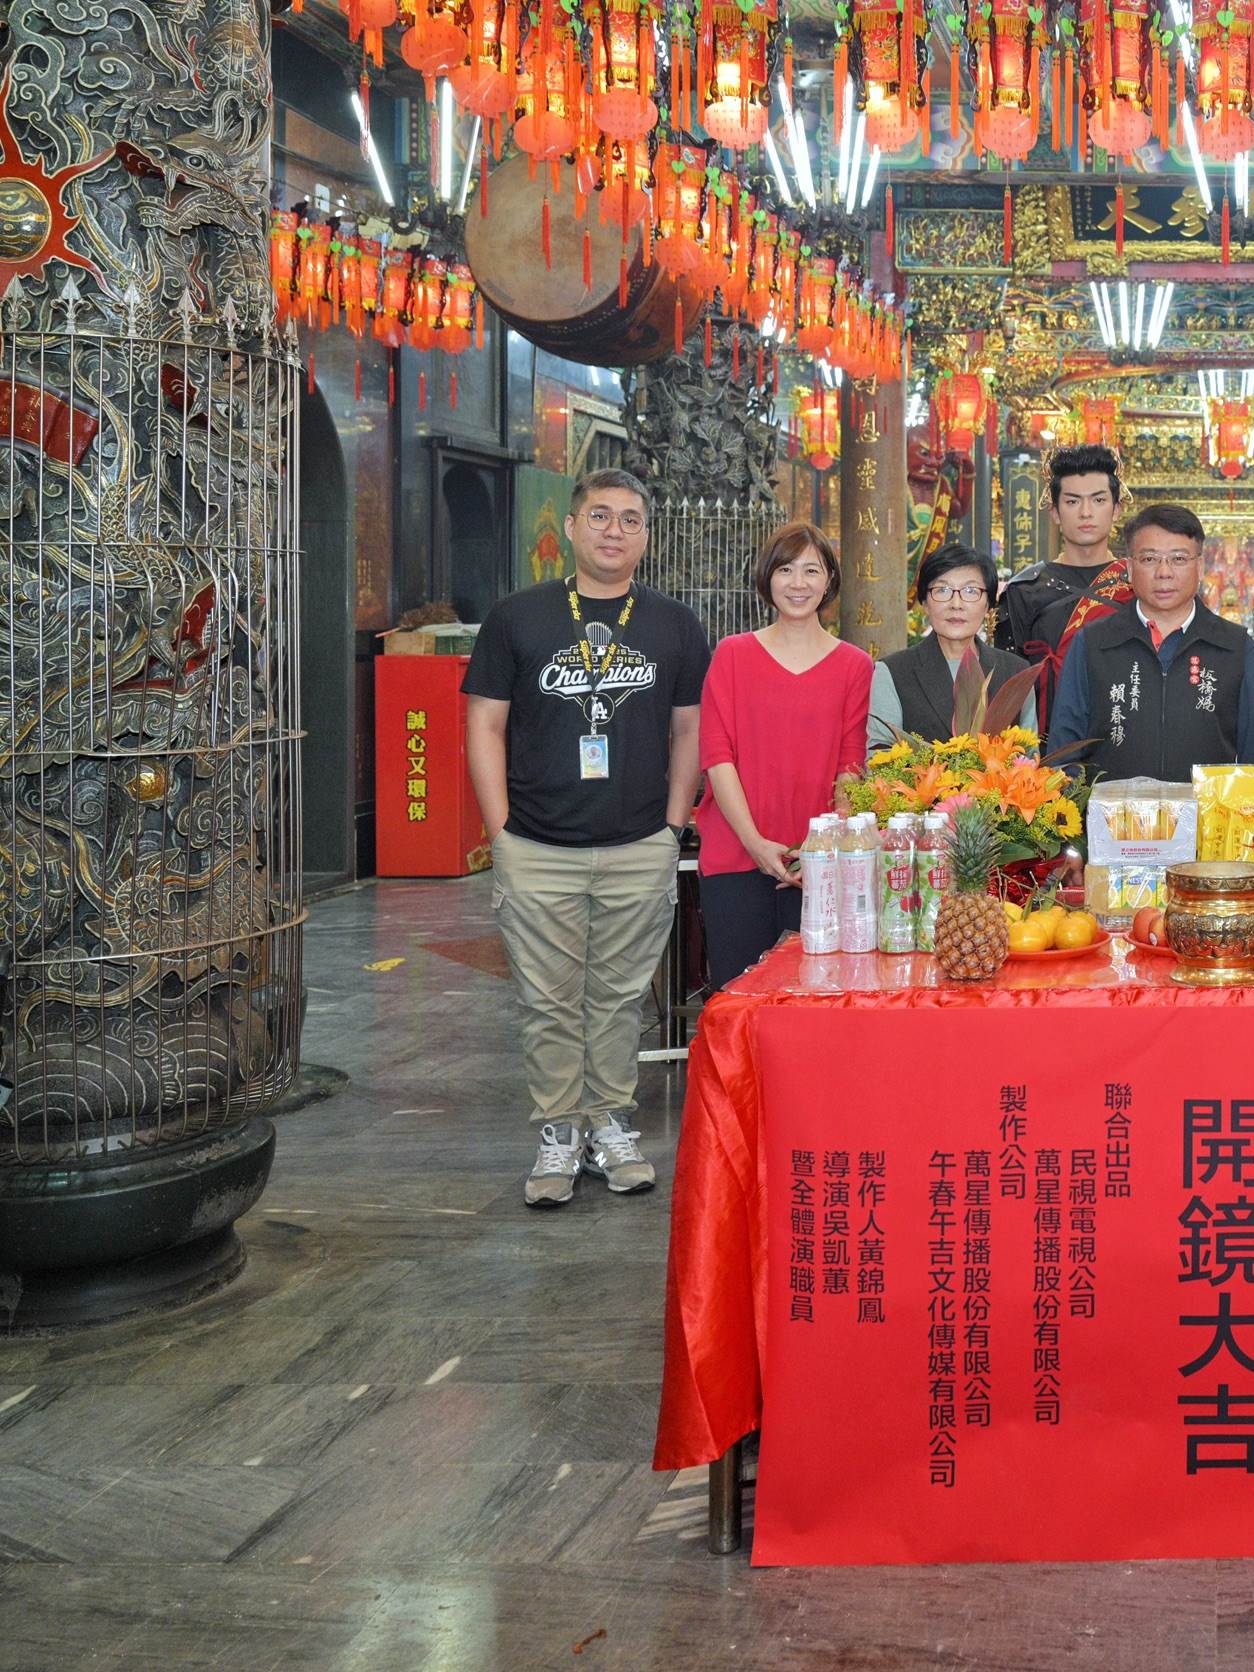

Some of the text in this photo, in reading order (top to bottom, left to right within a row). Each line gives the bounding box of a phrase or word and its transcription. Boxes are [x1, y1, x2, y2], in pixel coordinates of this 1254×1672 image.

[556, 656, 643, 665] WORD RIES
[406, 710, 427, 821] 誠心又環保
[823, 1151, 850, 1295] 導演吳凱蕙
[999, 1086, 1026, 1199] 製作公司
[1104, 1083, 1131, 1198] 聯合出品
[790, 1150, 815, 1323] 暨全體演職員
[857, 1151, 886, 1323] 製作人黃錦鳳
[927, 1150, 957, 1488] 午春午吉文化傳媒有限公司
[962, 1150, 992, 1428] 萬星傳播股份有限公司
[1033, 1149, 1061, 1425] 萬星傳播股份有限公司
[1068, 1149, 1097, 1319] 民視電視公司
